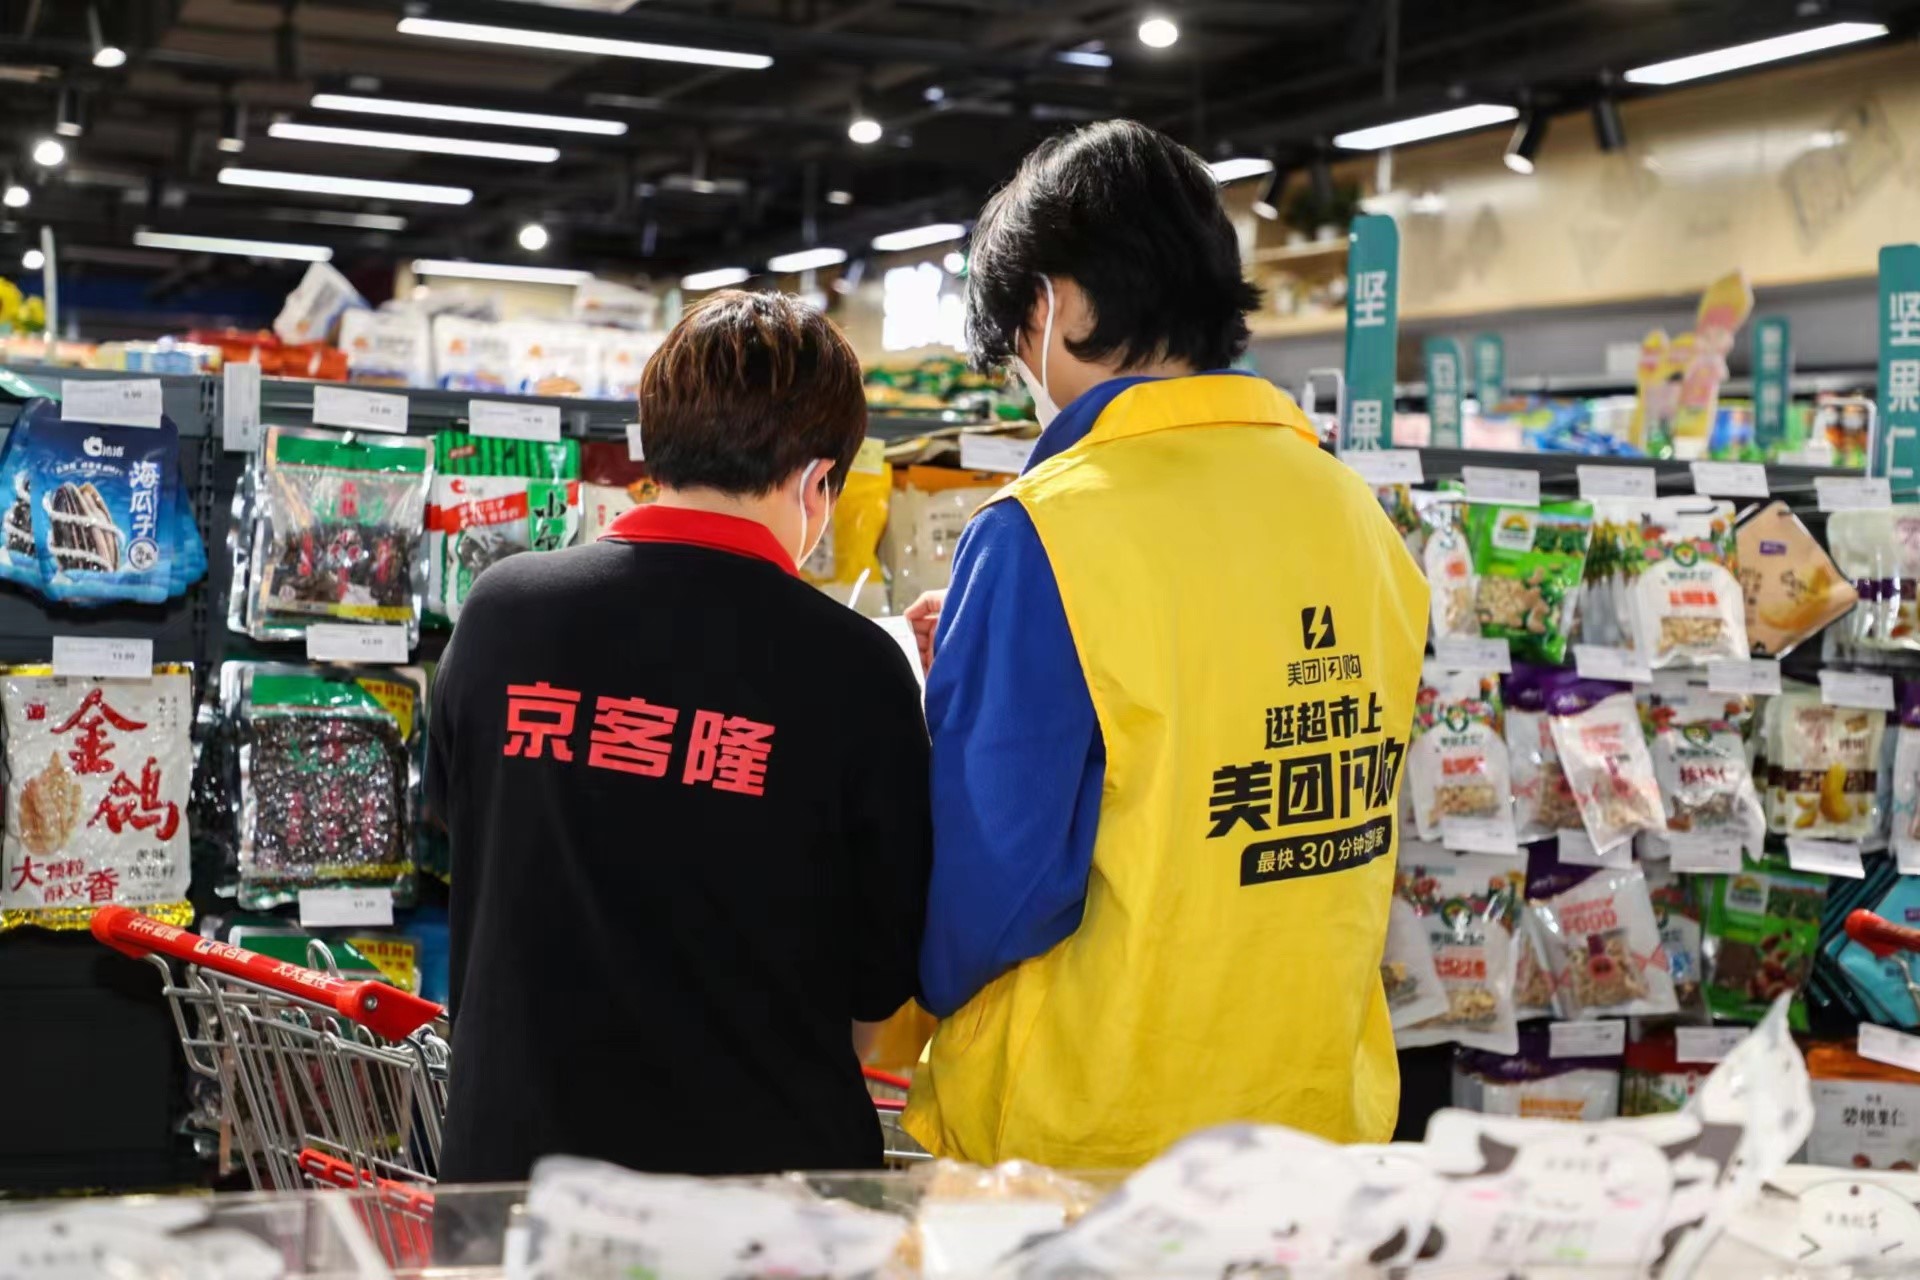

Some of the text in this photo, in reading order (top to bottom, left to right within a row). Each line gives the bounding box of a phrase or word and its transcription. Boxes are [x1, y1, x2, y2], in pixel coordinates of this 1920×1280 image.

[128, 460, 160, 538] 海瓜子
[1287, 654, 1363, 687] 美团闪购
[503, 681, 776, 797] 京客隆
[1264, 692, 1383, 750] 逛超市上
[51, 687, 179, 842] 金鸽
